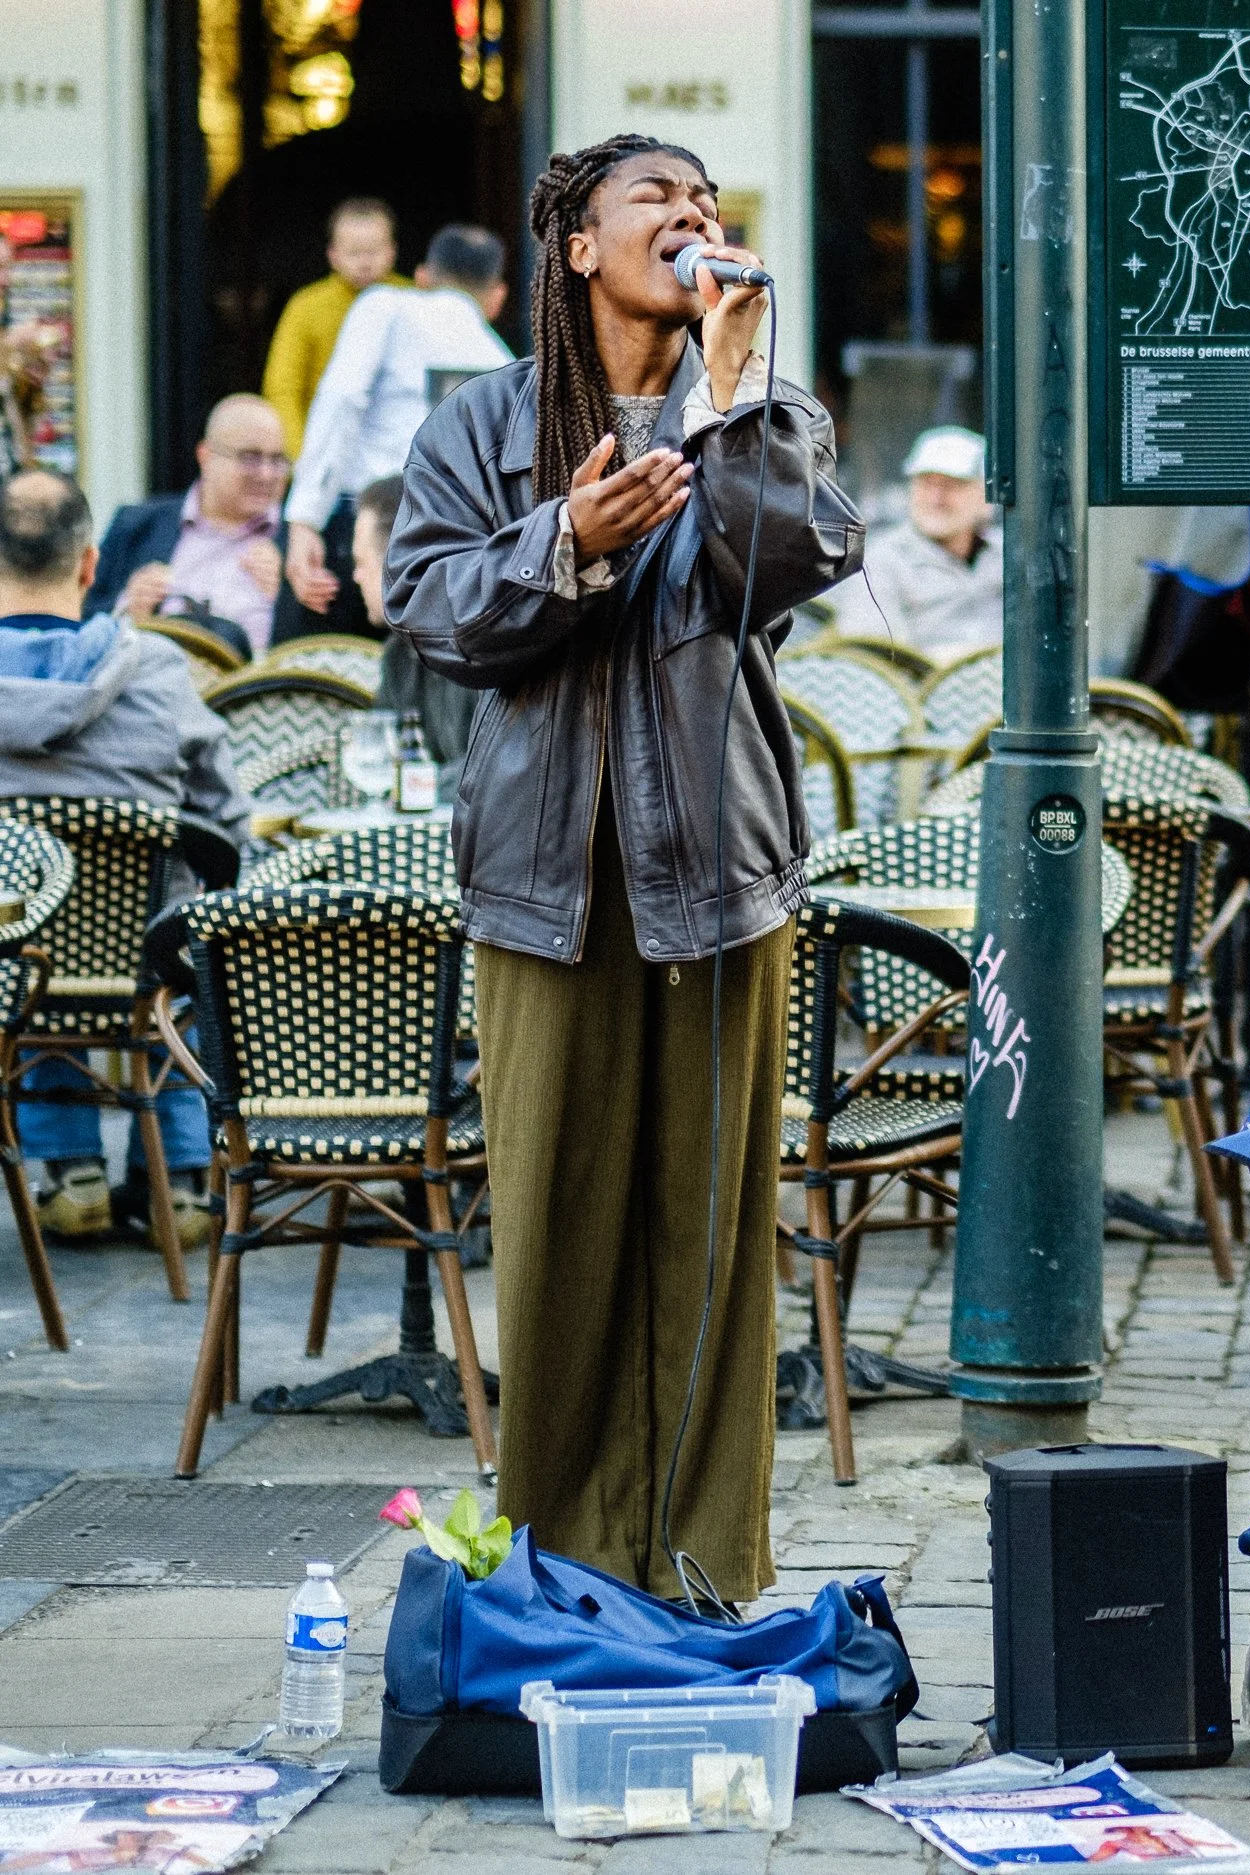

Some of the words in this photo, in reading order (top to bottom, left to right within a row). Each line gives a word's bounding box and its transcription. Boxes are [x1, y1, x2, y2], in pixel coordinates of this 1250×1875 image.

[1120, 346, 1136, 358] De
[1139, 346, 1194, 358] brusselse
[1040, 828, 1075, 841] 00088
[1085, 1603, 1164, 1621] BOSE
